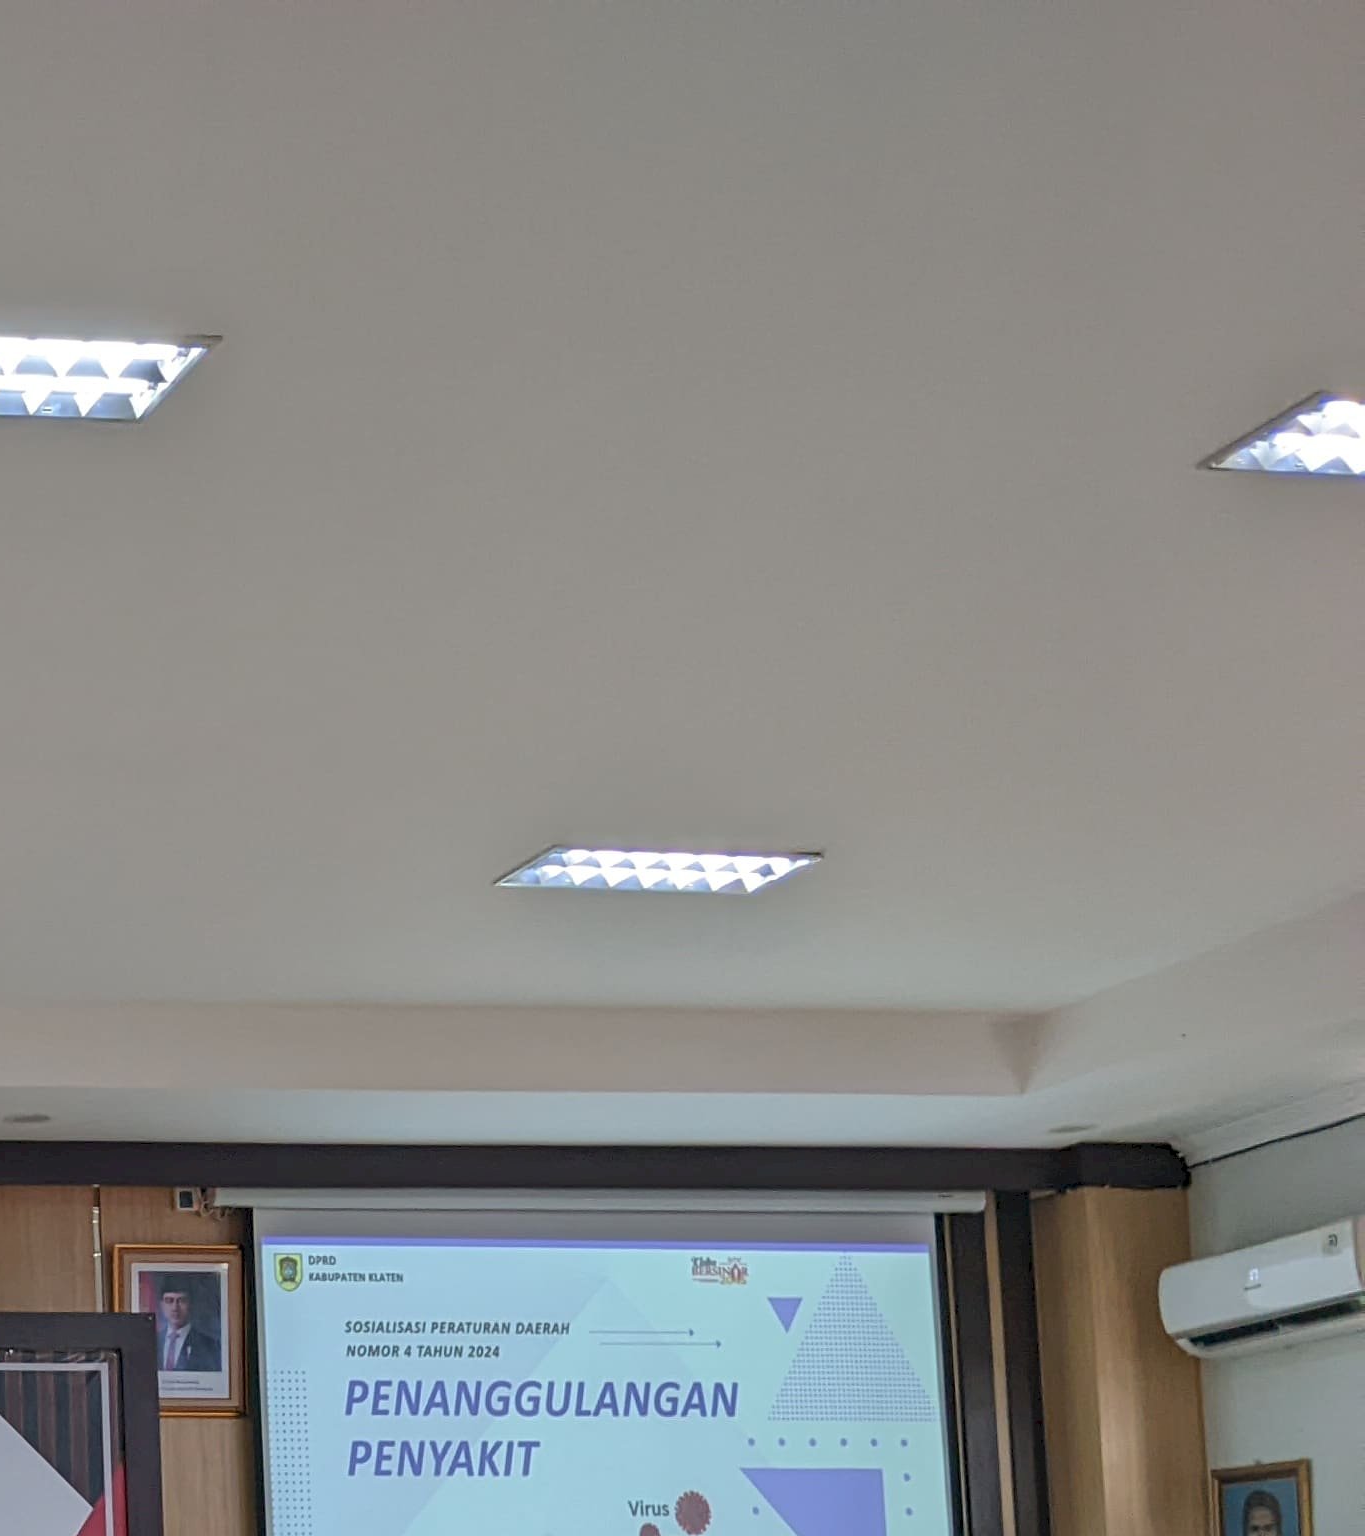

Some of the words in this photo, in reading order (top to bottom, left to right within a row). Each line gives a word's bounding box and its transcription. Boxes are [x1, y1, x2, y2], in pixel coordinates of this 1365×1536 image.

[308, 1255, 337, 1266] DPRD
[309, 1272, 366, 1282] KABUPATEN
[369, 1272, 404, 1283] KLATEN
[344, 1320, 426, 1334] SOSIALISASI
[430, 1321, 511, 1335] PERATURAN
[515, 1322, 570, 1336] DAERAH
[346, 1344, 400, 1358] NOMOR
[403, 1345, 413, 1358] 4
[417, 1345, 464, 1358] TAHUN
[467, 1346, 500, 1359] 2024
[344, 1379, 740, 1419] PENANGGULANGAN
[346, 1440, 541, 1478] PENYAKIT
[627, 1499, 670, 1517] Virus
